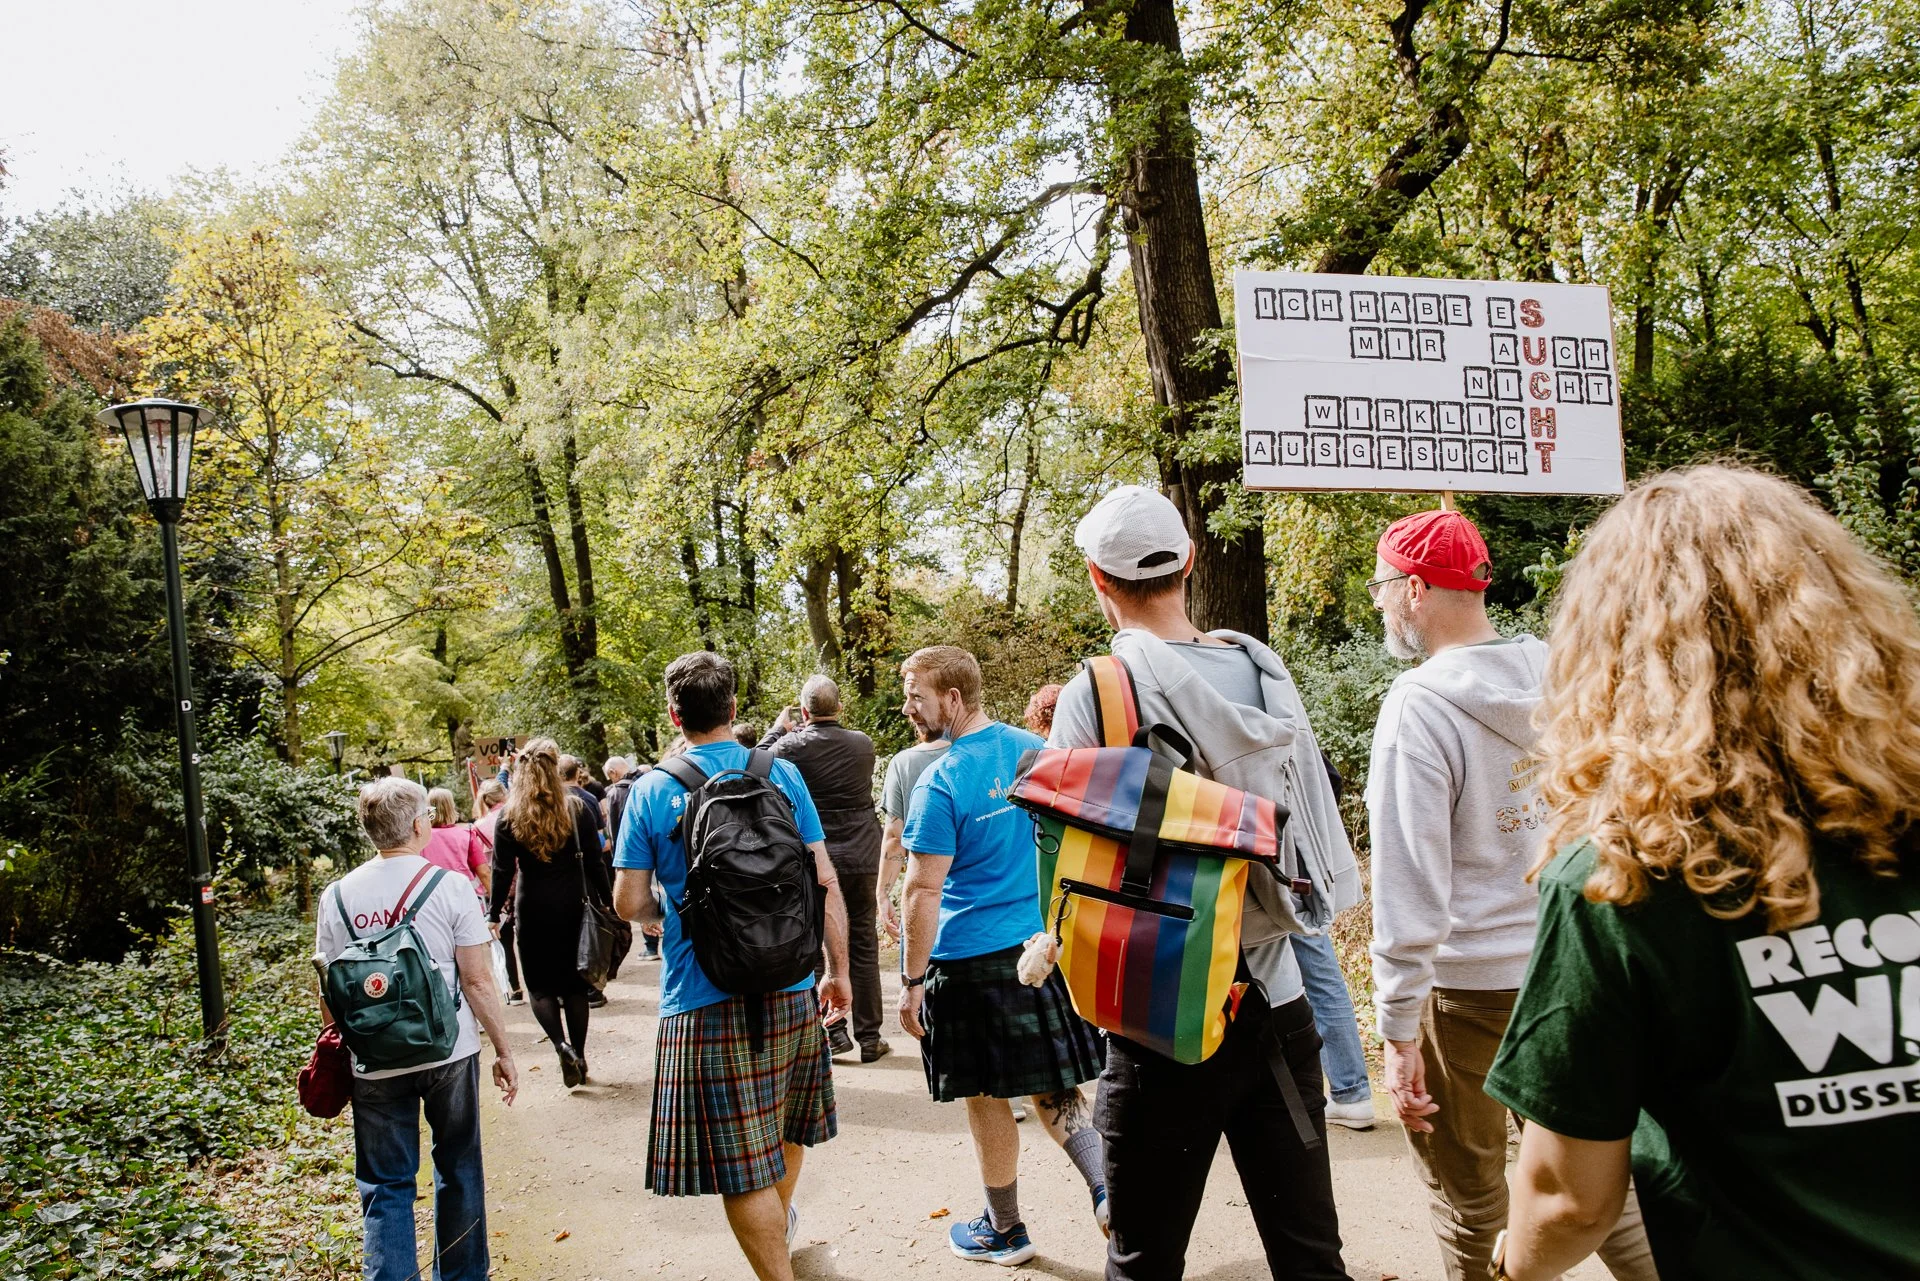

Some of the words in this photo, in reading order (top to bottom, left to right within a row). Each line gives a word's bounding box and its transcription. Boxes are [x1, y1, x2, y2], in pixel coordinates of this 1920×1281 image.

[1356, 297, 1465, 319] HABE
[1498, 336, 1601, 366] AUCH
[1471, 371, 1604, 400] NICHT
[1313, 404, 1557, 439] WIRKLICH
[1253, 440, 1556, 473] AUSGESUCHT
[1736, 911, 1920, 989] RECO
[1786, 1080, 1920, 1117] DÜSSE
